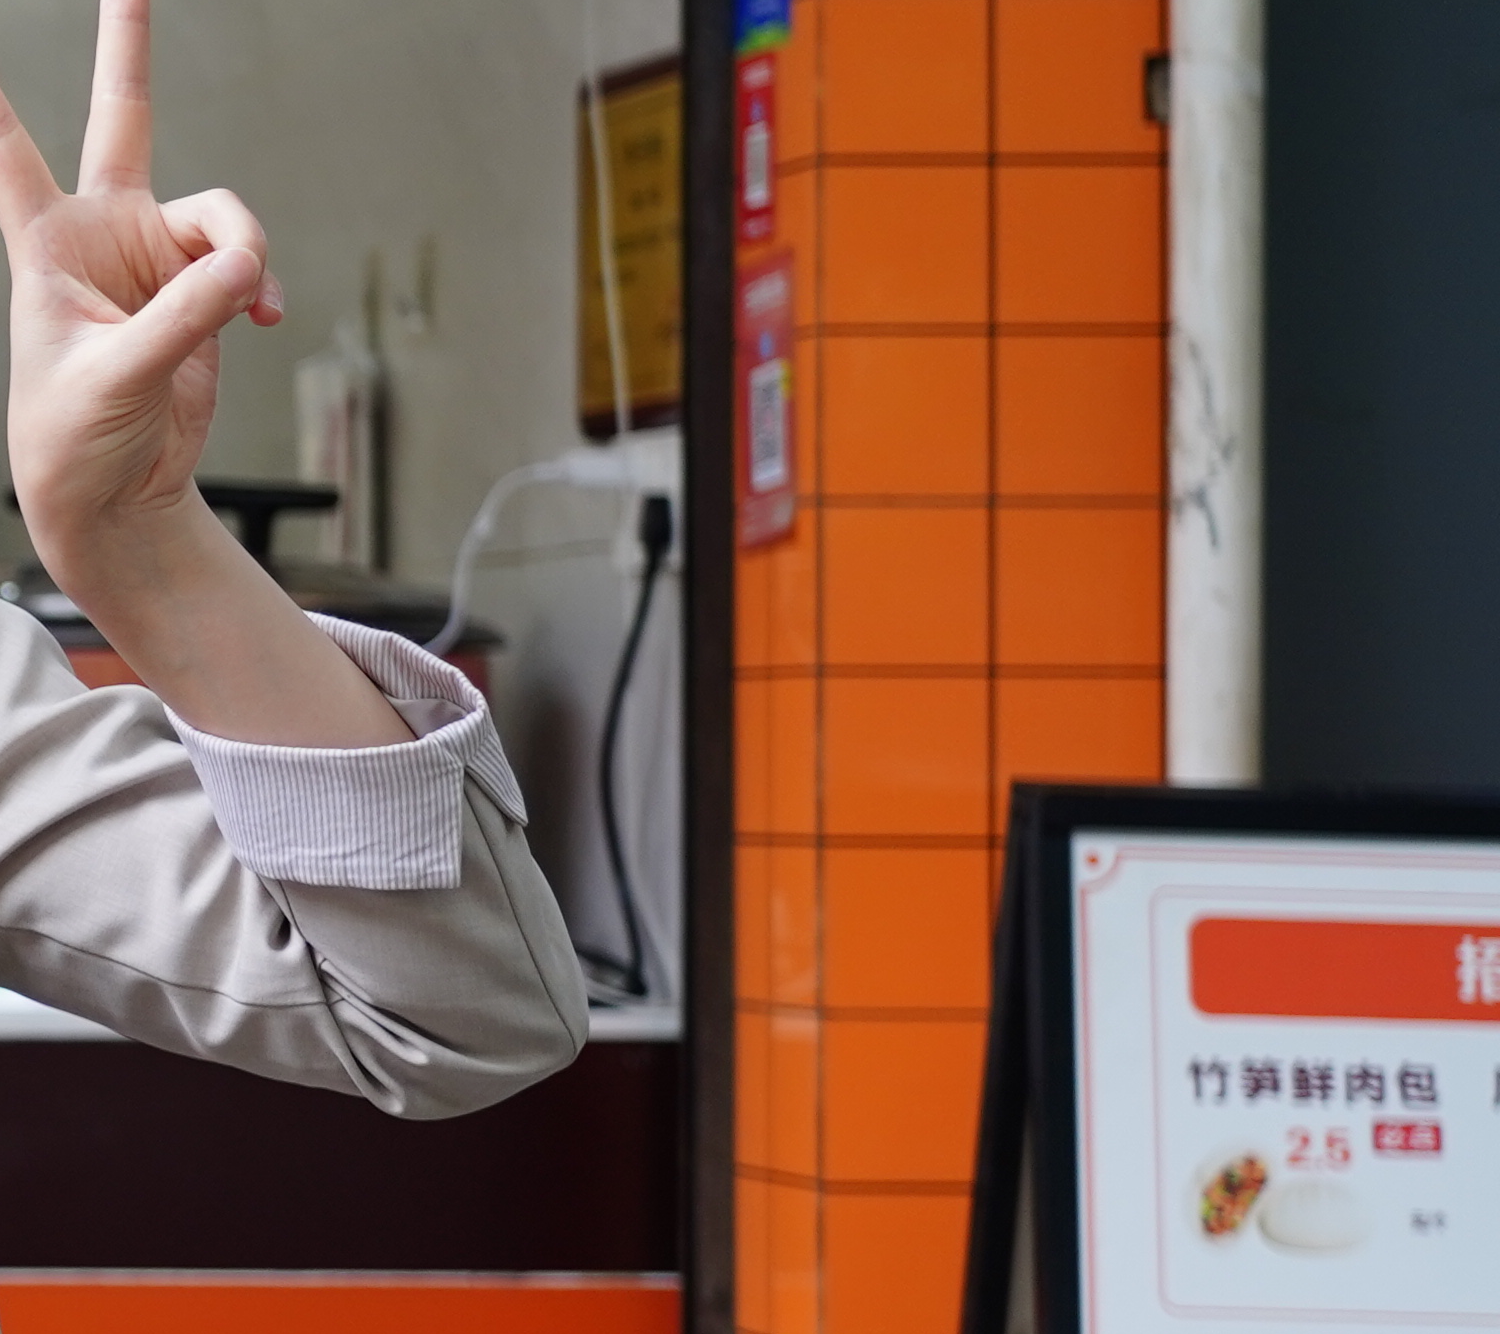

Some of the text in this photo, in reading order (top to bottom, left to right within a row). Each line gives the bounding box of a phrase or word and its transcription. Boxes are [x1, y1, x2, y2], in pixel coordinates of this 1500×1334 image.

[1189, 1057, 1439, 1107] 竹笋鲜肉包
